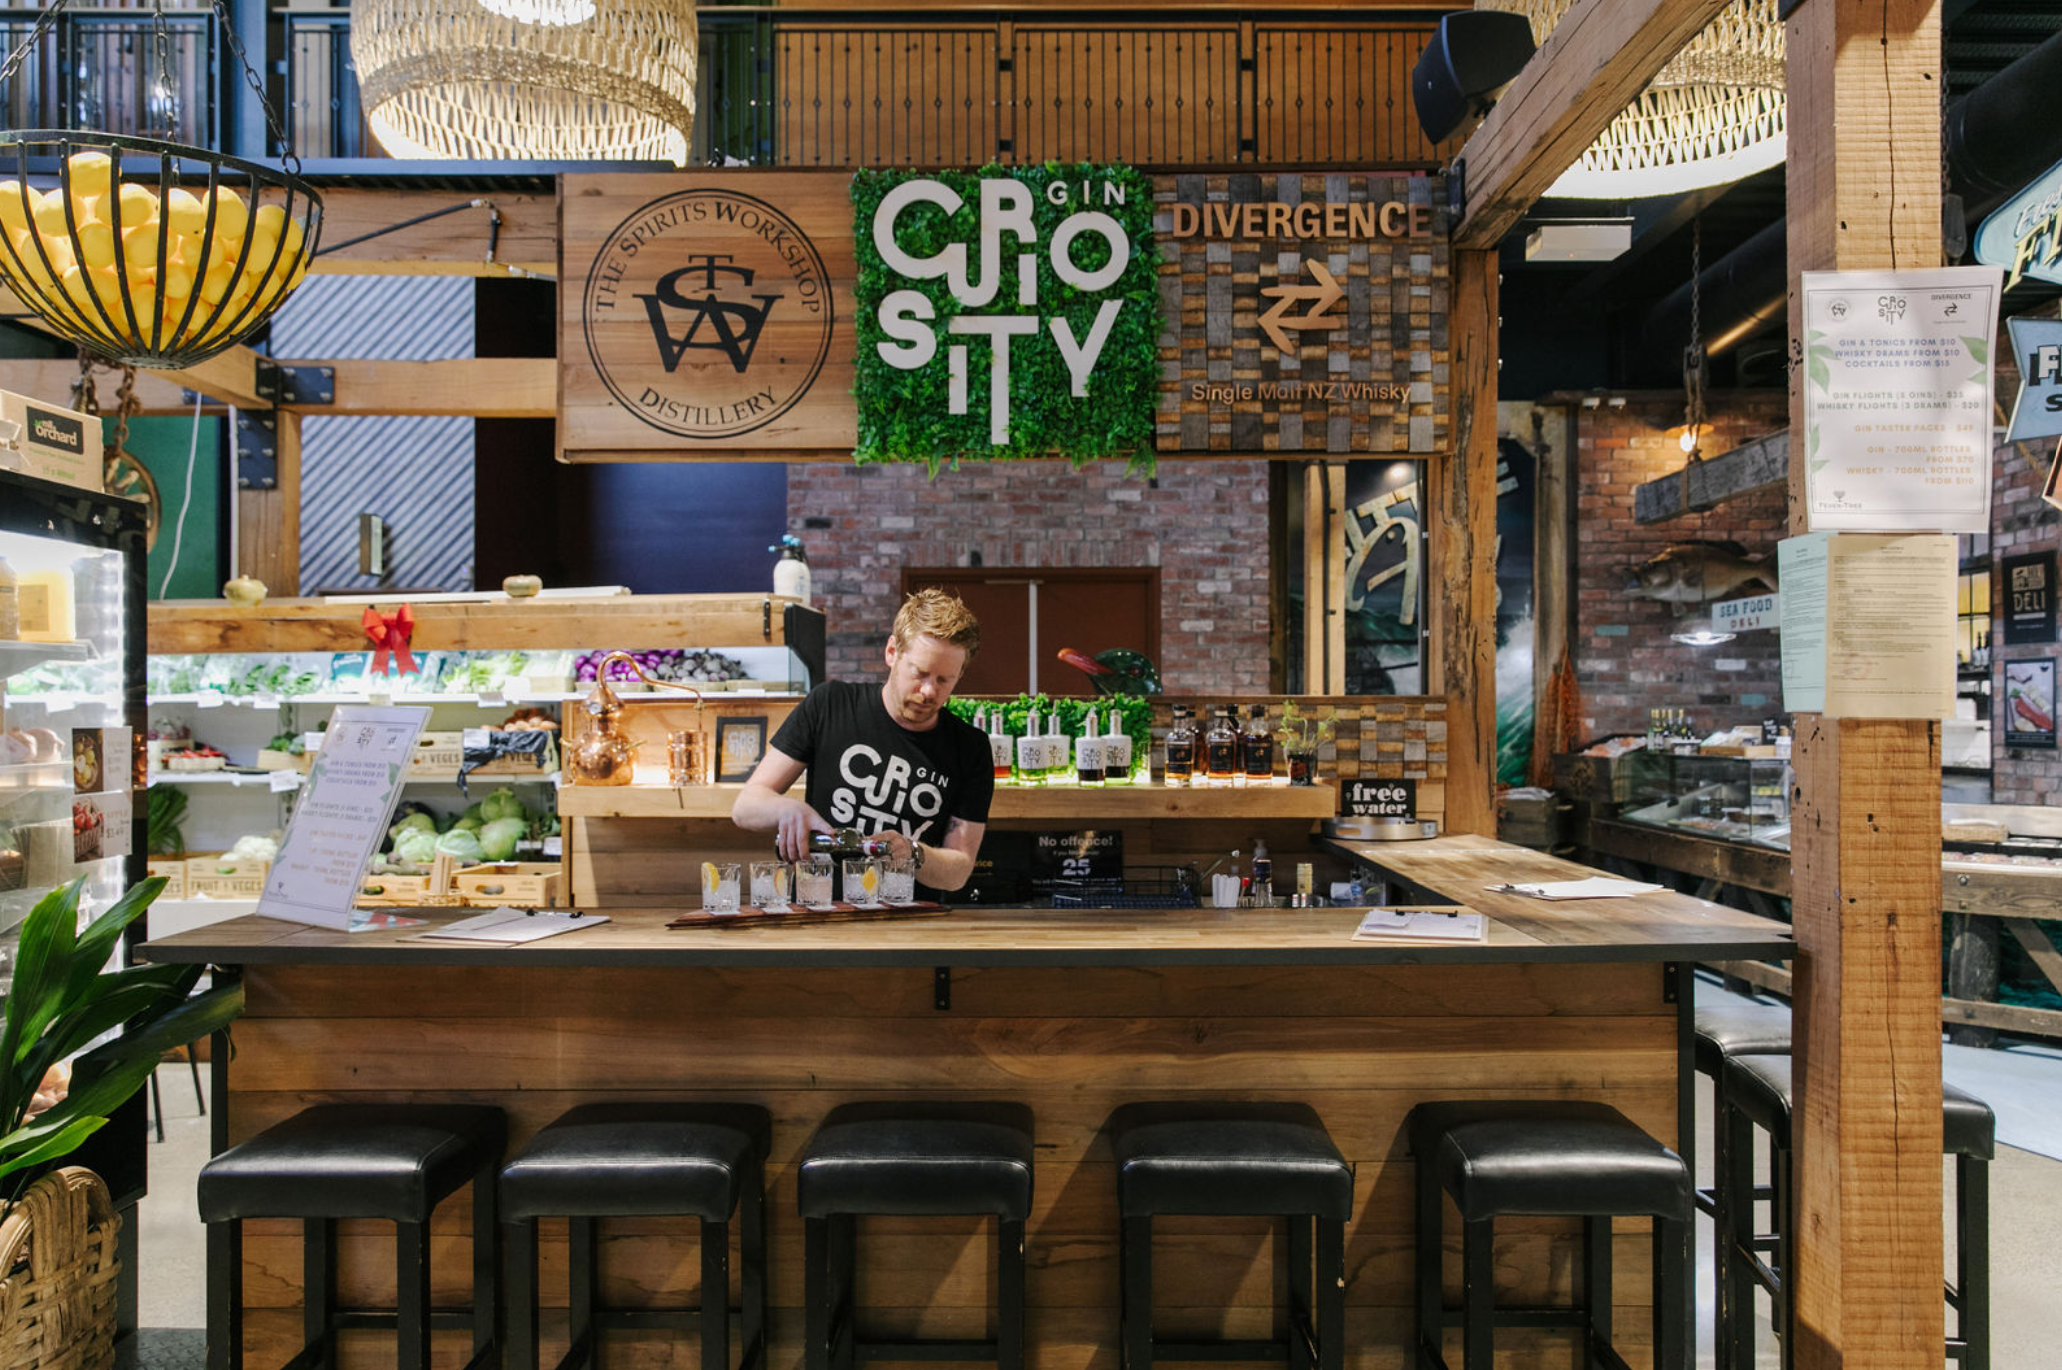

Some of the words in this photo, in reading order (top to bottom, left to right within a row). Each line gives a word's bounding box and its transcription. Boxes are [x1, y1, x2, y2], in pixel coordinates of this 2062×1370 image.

[1047, 180, 1125, 205] GIN
[1172, 201, 1432, 238] DIVERGENCE
[595, 257, 627, 312] THE
[620, 201, 707, 258] SPIRITS
[715, 201, 820, 314] WORKSHOP
[1869, 339, 1906, 347] TONICS
[1908, 339, 1937, 347] FROM
[1939, 338, 1957, 347] $10
[1834, 350, 1872, 358] WHISKY
[1875, 350, 1910, 358] DRAMS
[1944, 349, 1960, 357] $10
[1844, 360, 1900, 368] COCKTAILS
[1904, 360, 1931, 368] FROM
[1191, 384, 1252, 404] Single
[1258, 382, 1303, 400] Malt
[1307, 383, 1337, 400] NZ
[1340, 382, 1411, 404] Whisky
[1853, 392, 1893, 400] FLIGHTS
[639, 385, 777, 425] DISTILLERY
[1817, 402, 1854, 410] WHISKY
[1857, 402, 1898, 410] FLIGHTS
[1720, 603, 1739, 618] SEA
[1742, 598, 1773, 615] FOOD
[2013, 590, 2045, 613] DELI
[1730, 616, 1759, 629] DELI
[430, 752, 460, 764] VEGES
[916, 767, 949, 789] GIN
[1352, 783, 1407, 801] free
[1351, 802, 1407, 814] water
[1038, 836, 1057, 847] No
[1062, 858, 1092, 876] 25
